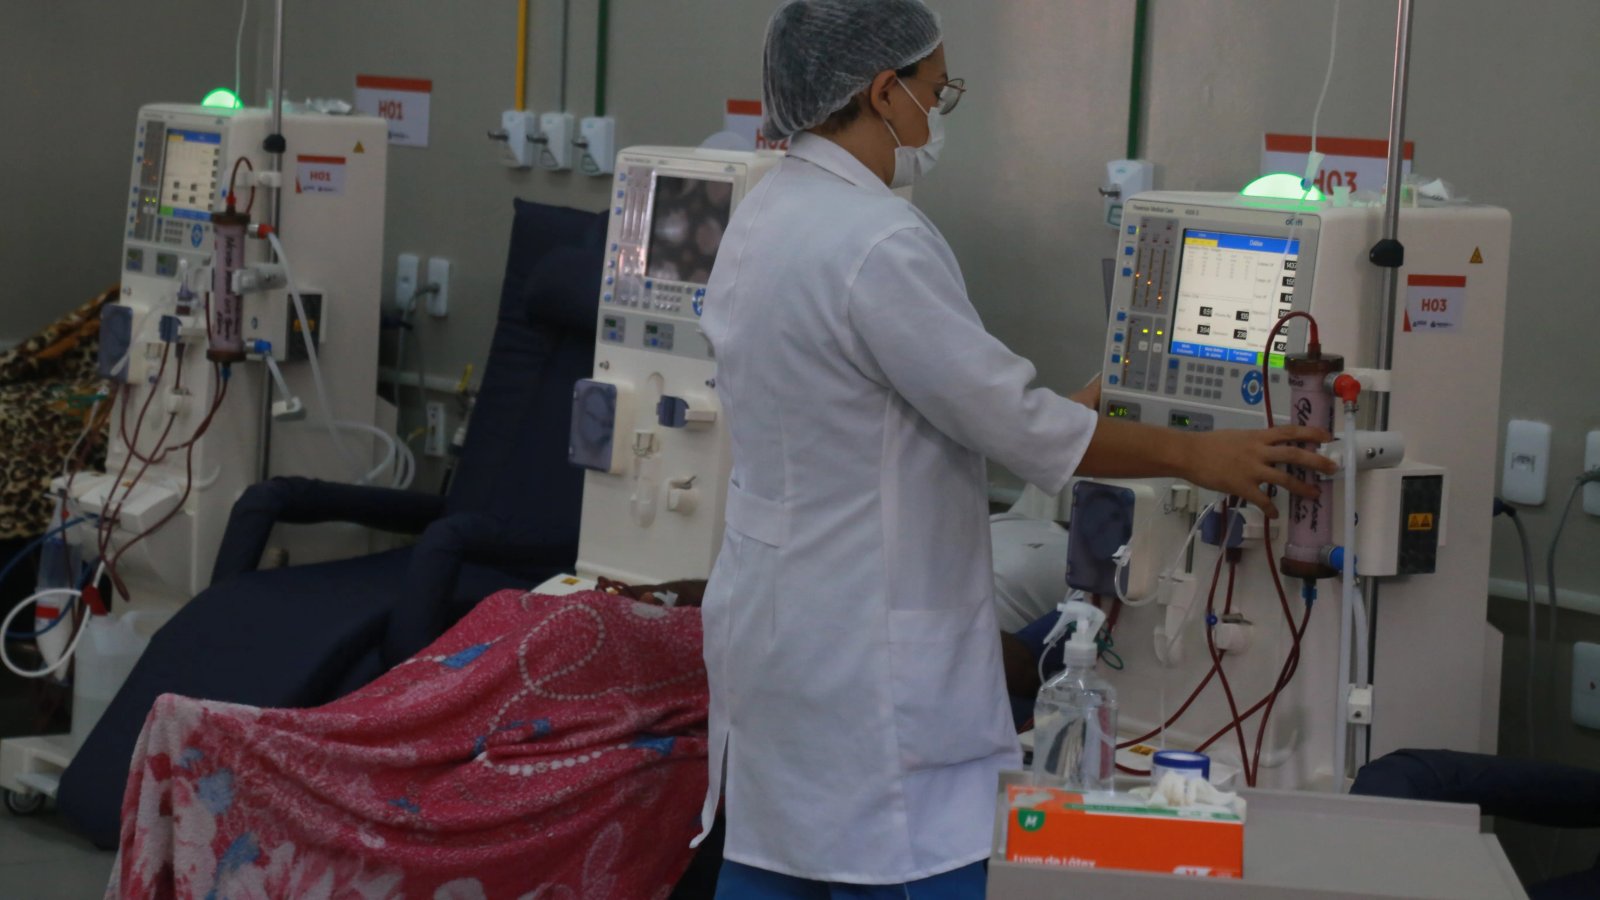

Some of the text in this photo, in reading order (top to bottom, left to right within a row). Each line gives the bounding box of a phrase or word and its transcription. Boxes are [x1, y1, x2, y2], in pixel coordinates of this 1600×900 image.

[378, 100, 403, 120] H01
[310, 171, 332, 182] H01
[1421, 298, 1447, 312] H03
[1024, 815, 1038, 828] M
